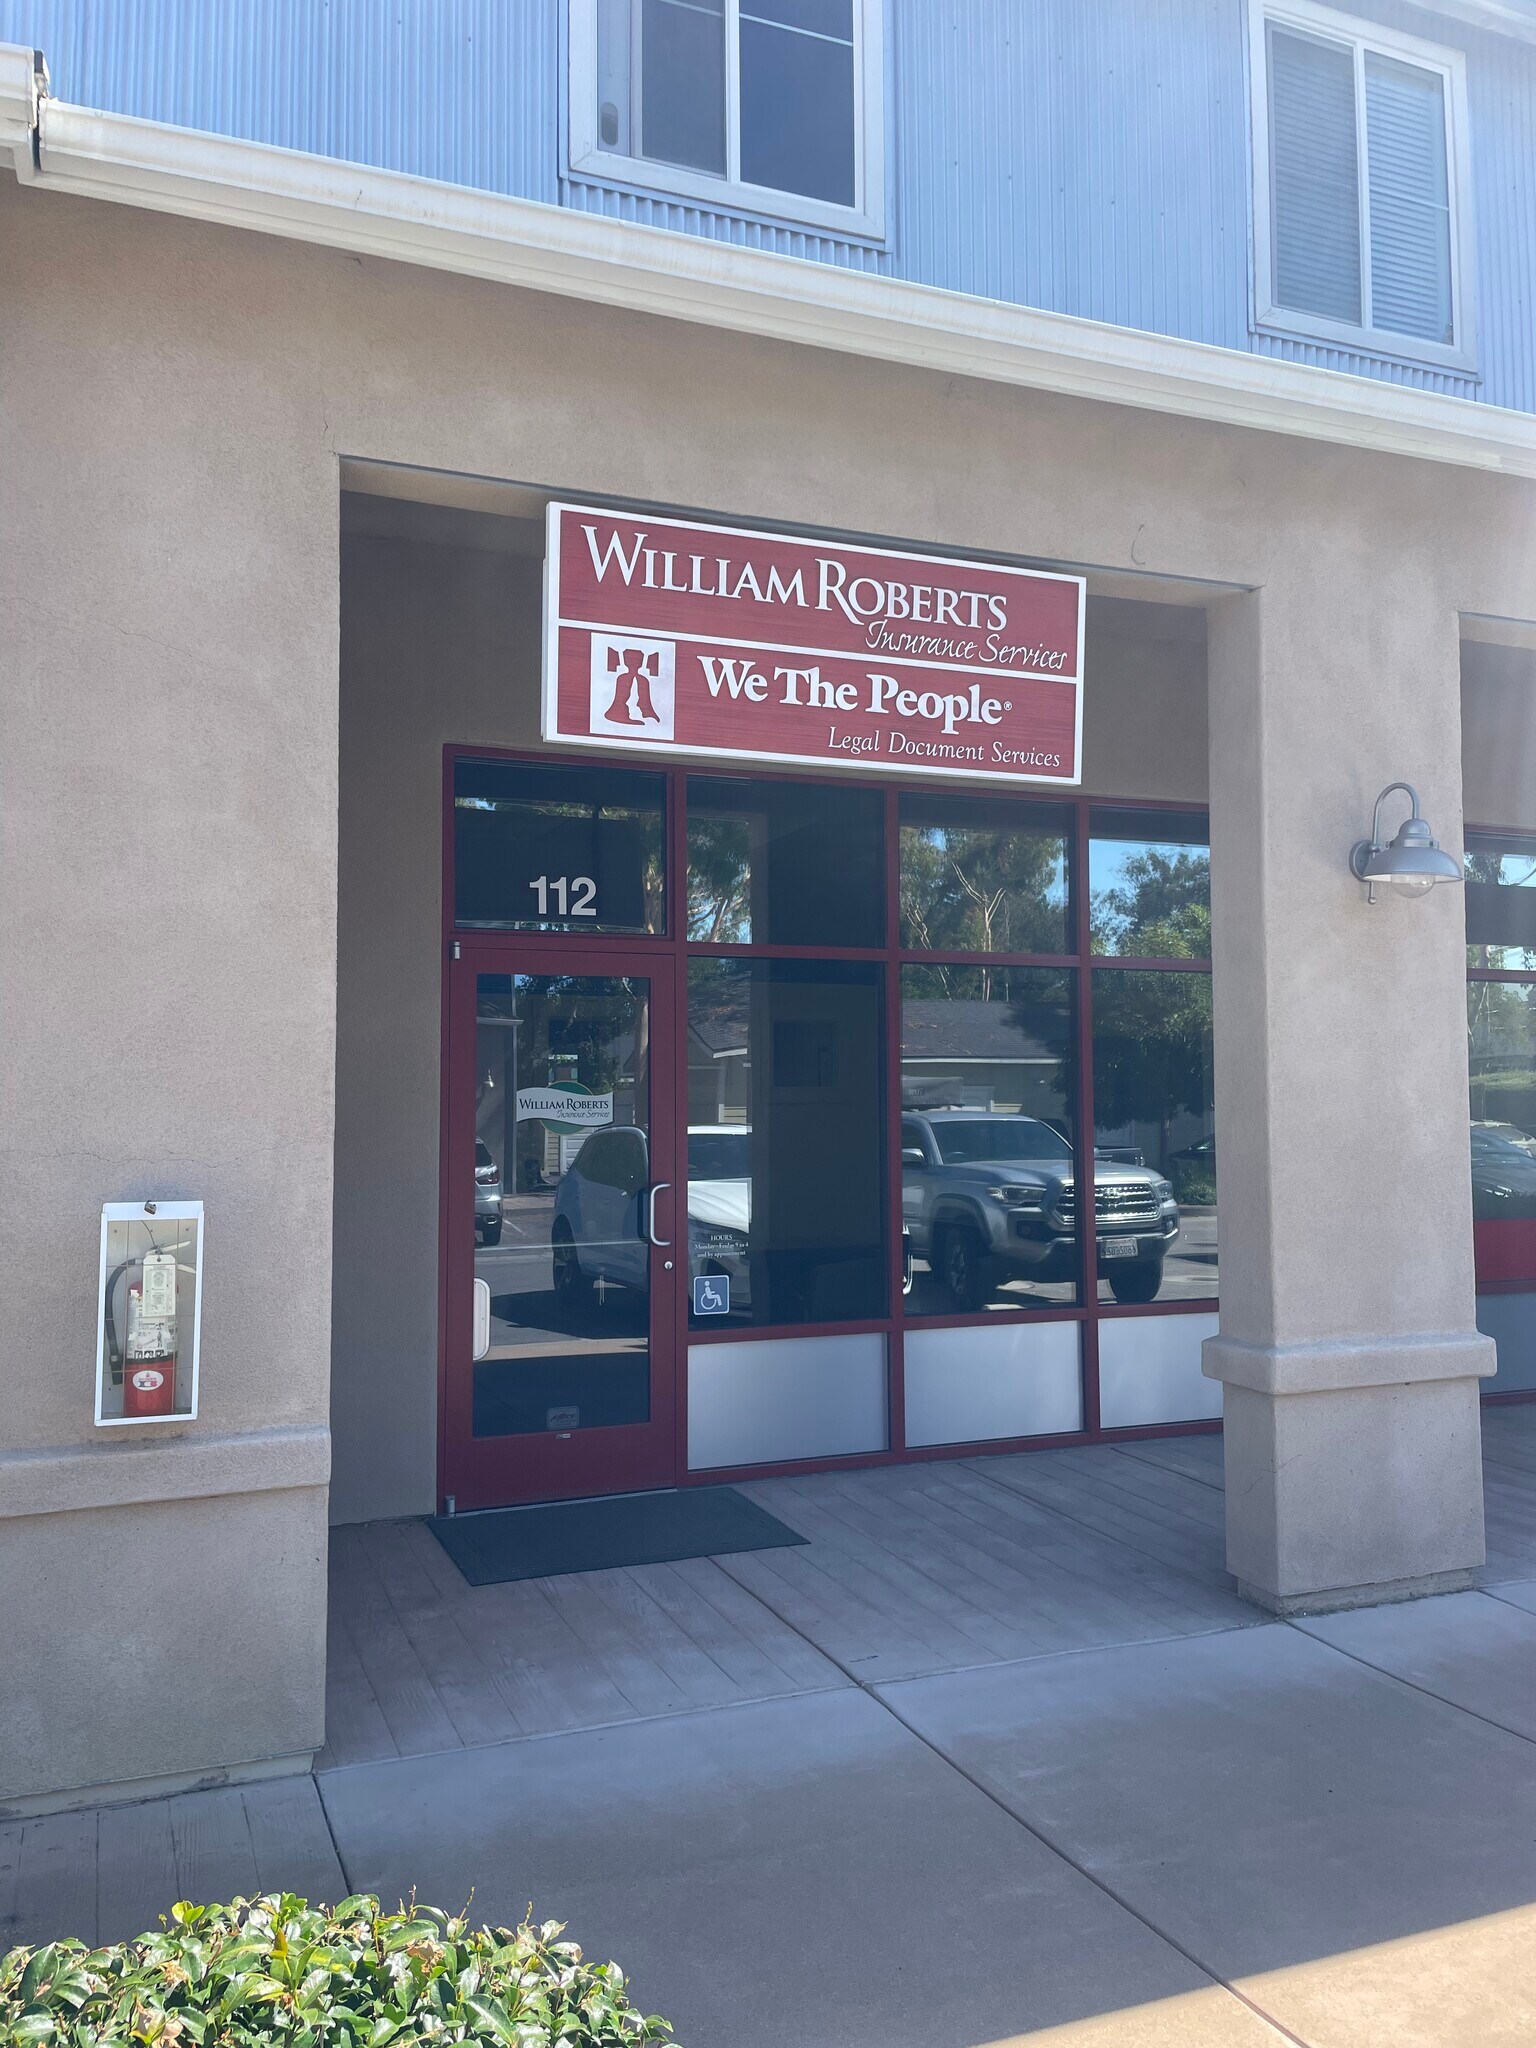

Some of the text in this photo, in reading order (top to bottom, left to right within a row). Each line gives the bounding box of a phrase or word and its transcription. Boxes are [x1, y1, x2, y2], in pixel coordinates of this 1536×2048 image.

[580, 524, 1007, 631] WILLIAM ROBERTS
[865, 619, 1068, 670] Insurance Services
[696, 655, 769, 702] We
[773, 666, 858, 711] The
[828, 726, 1061, 767] Legal Document Services
[529, 875, 597, 916] 112
[519, 1098, 609, 1111] WILLIAM ROBERTS
